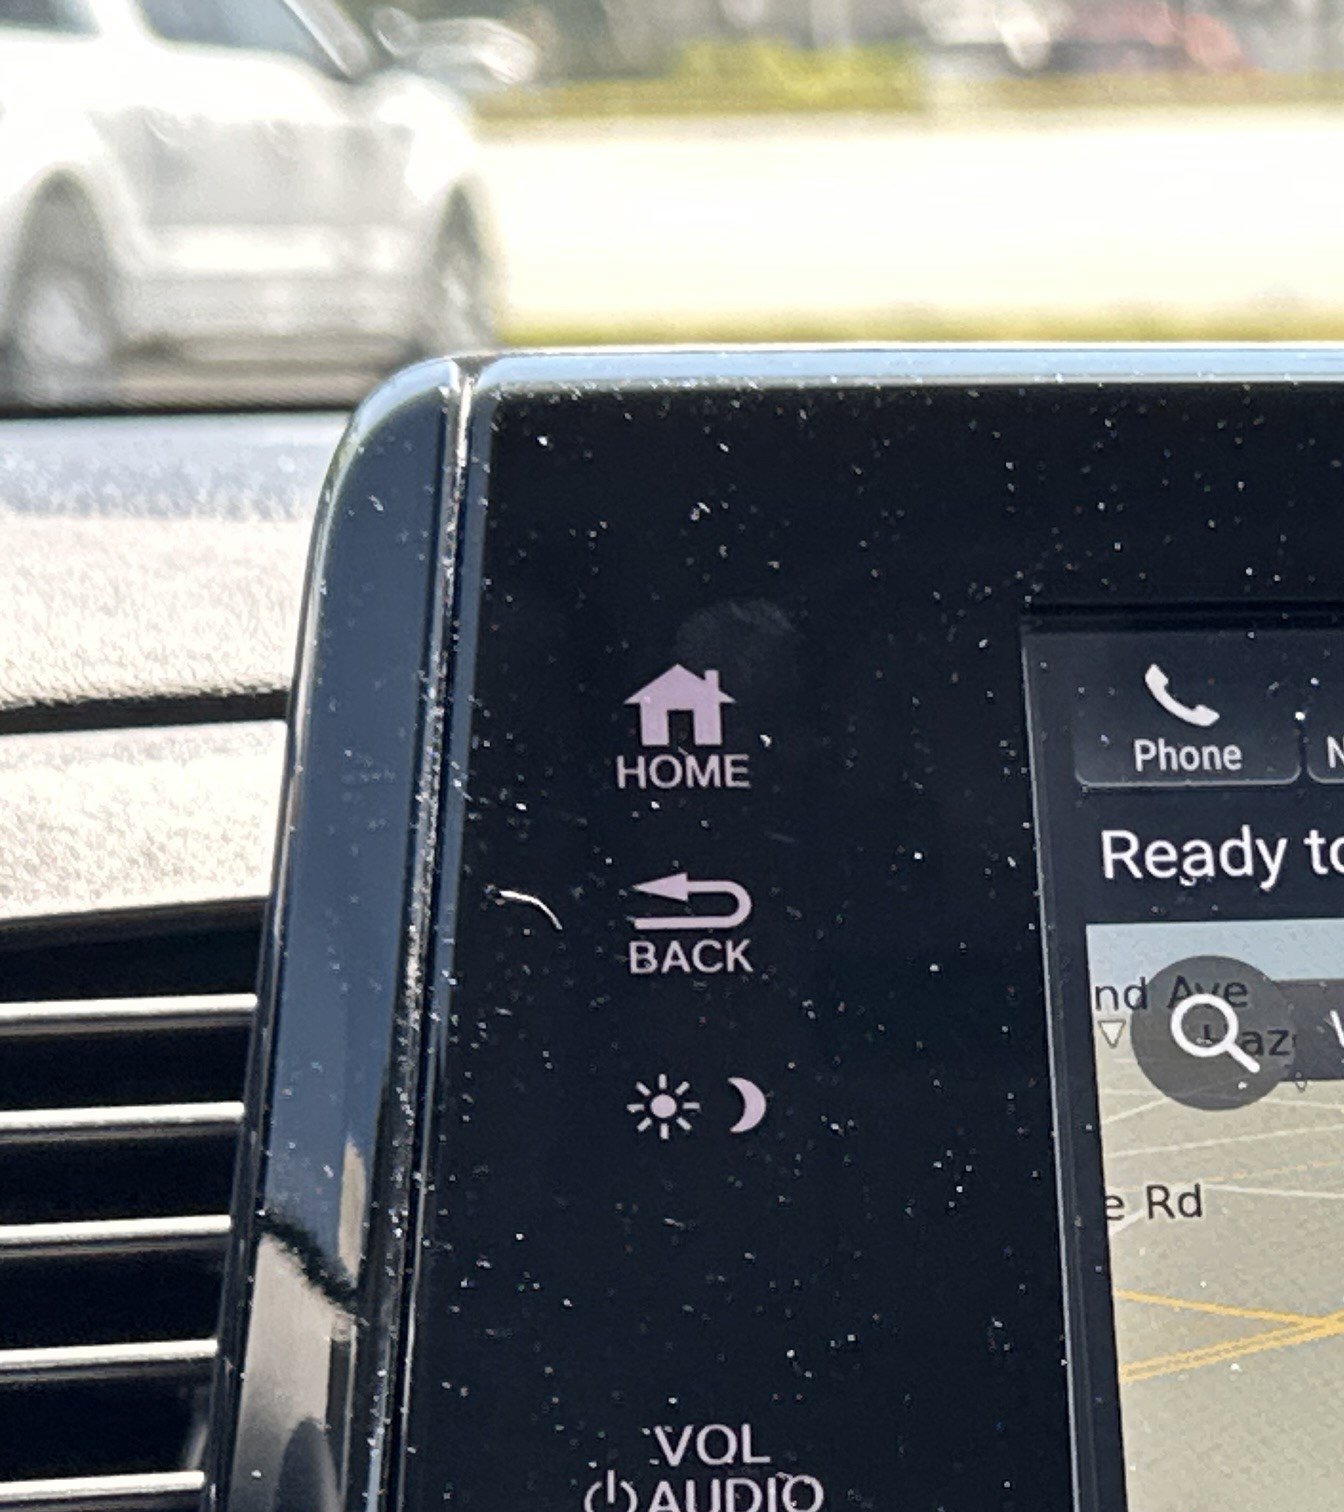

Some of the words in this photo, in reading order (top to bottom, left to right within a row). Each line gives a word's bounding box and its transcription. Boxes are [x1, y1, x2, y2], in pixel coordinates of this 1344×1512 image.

[616, 754, 751, 790] HOME
[1133, 738, 1243, 773] Phone
[1100, 826, 1288, 890] Ready
[628, 939, 754, 975] BACK
[1145, 1182, 1203, 1220] Rd
[653, 1423, 771, 1467] VOL
